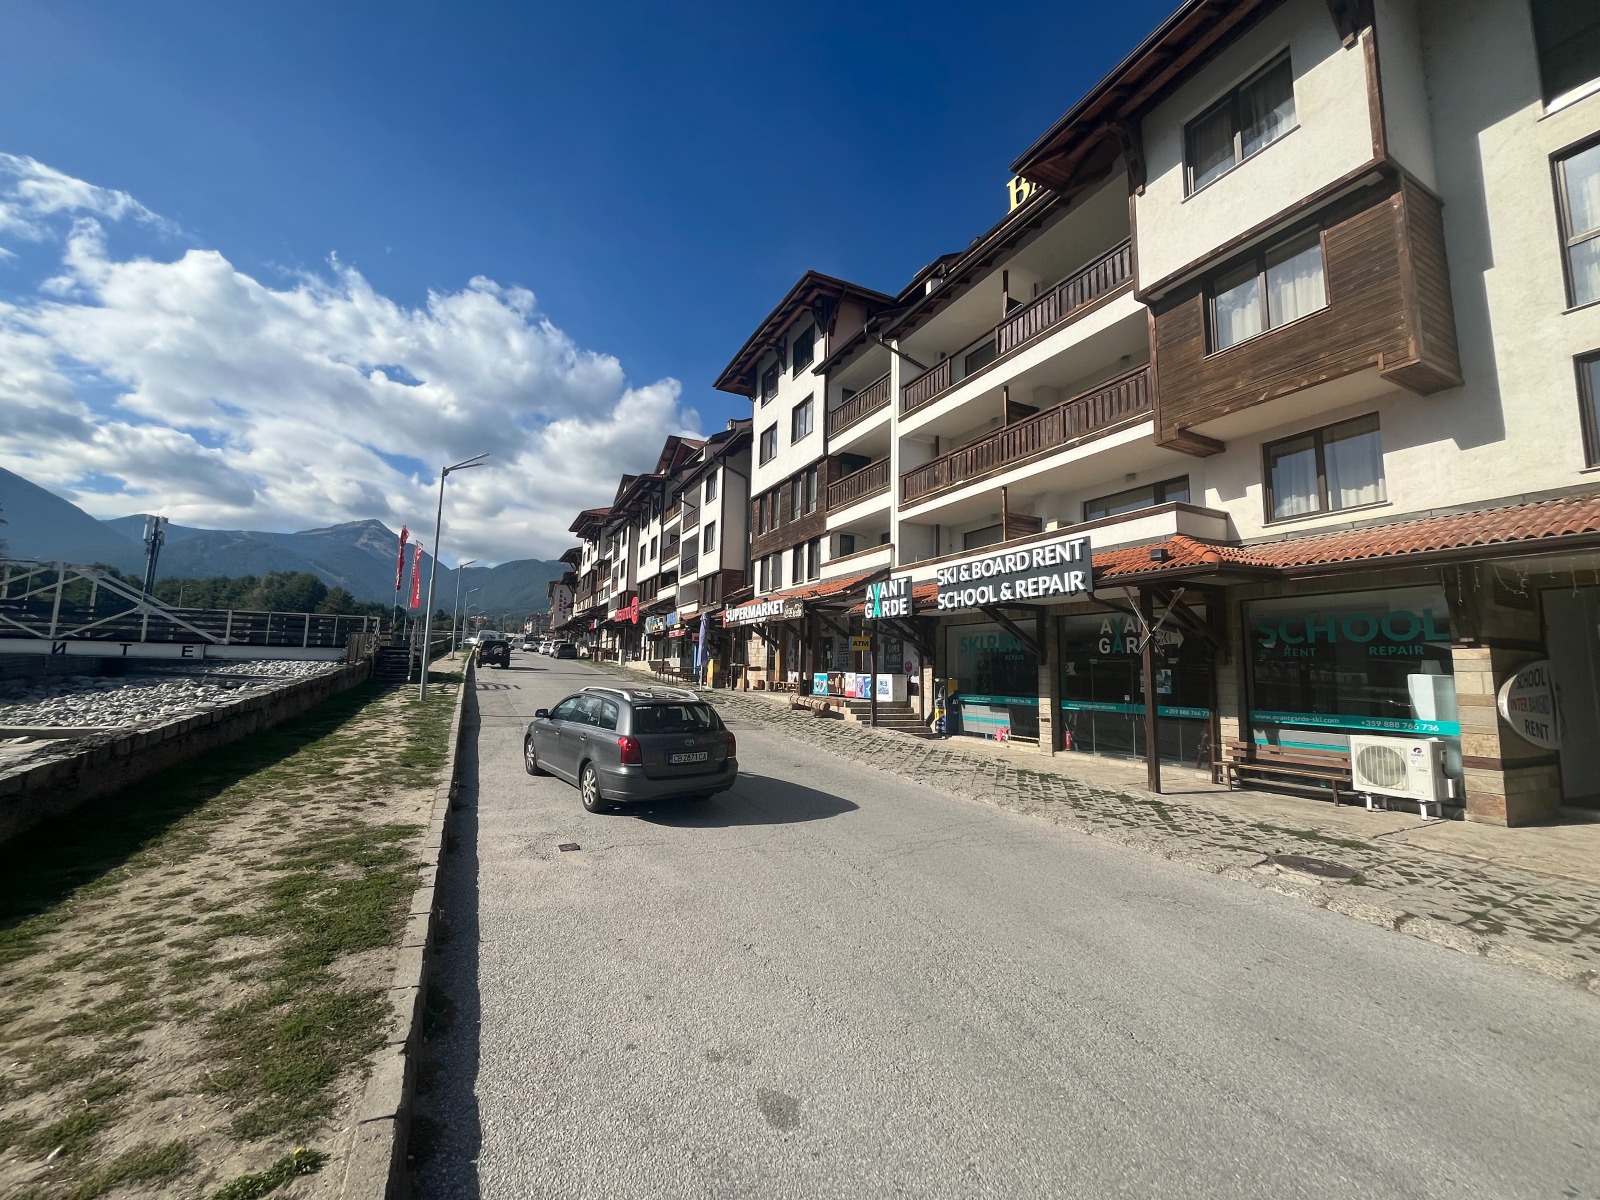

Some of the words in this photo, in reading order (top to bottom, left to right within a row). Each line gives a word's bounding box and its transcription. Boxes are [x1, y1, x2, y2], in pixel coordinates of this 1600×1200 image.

[937, 567, 958, 587] SKI
[959, 563, 972, 582] &
[971, 551, 1031, 580] BOARD
[1032, 538, 1084, 568] RENT
[866, 578, 908, 600] AVANT
[937, 584, 998, 610] SCHOOL
[1000, 581, 1014, 601] &
[1015, 570, 1087, 599] REPAIR
[725, 600, 784, 623] SUPERMARKET
[865, 597, 908, 619] GARDE
[1257, 608, 1452, 644] SCHOOL
[1284, 647, 1316, 657] RENT
[1369, 645, 1425, 656] REPAIR
[1516, 667, 1547, 690] SCHOOL
[1254, 713, 1339, 724] www.avantgarde-ski.com
[1361, 719, 1382, 728] +359
[1383, 720, 1400, 729] 888
[1402, 721, 1419, 730] 766
[1421, 722, 1440, 732] 736
[1524, 719, 1549, 742] RENT
